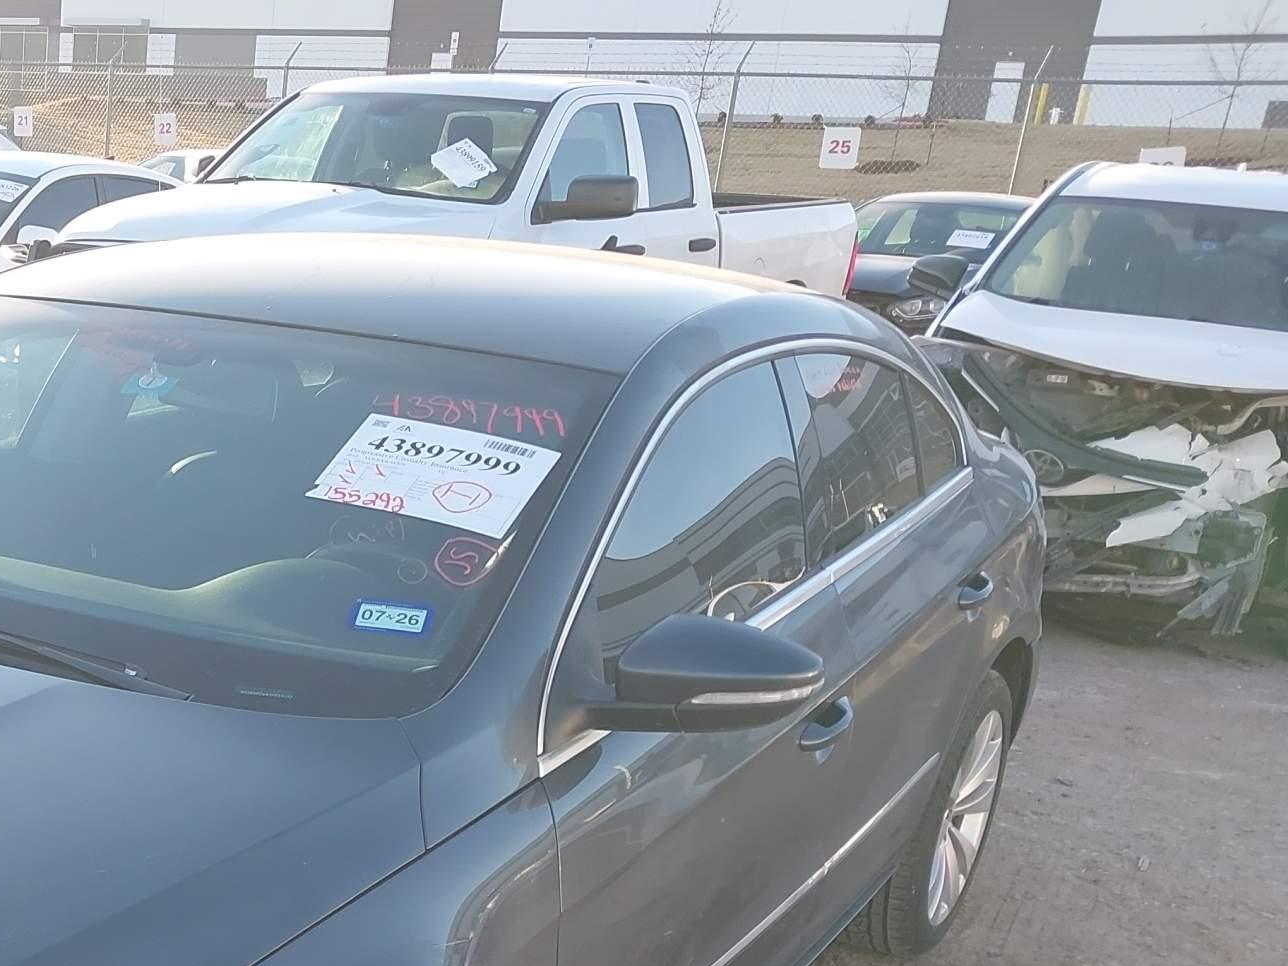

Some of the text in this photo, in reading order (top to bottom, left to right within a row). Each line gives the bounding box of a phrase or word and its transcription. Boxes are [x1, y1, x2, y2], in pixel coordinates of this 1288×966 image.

[17, 115, 29, 126] 21
[158, 123, 172, 134] 22
[828, 140, 852, 154] 25
[372, 393, 566, 437] 43897999
[367, 435, 521, 476] 43897999
